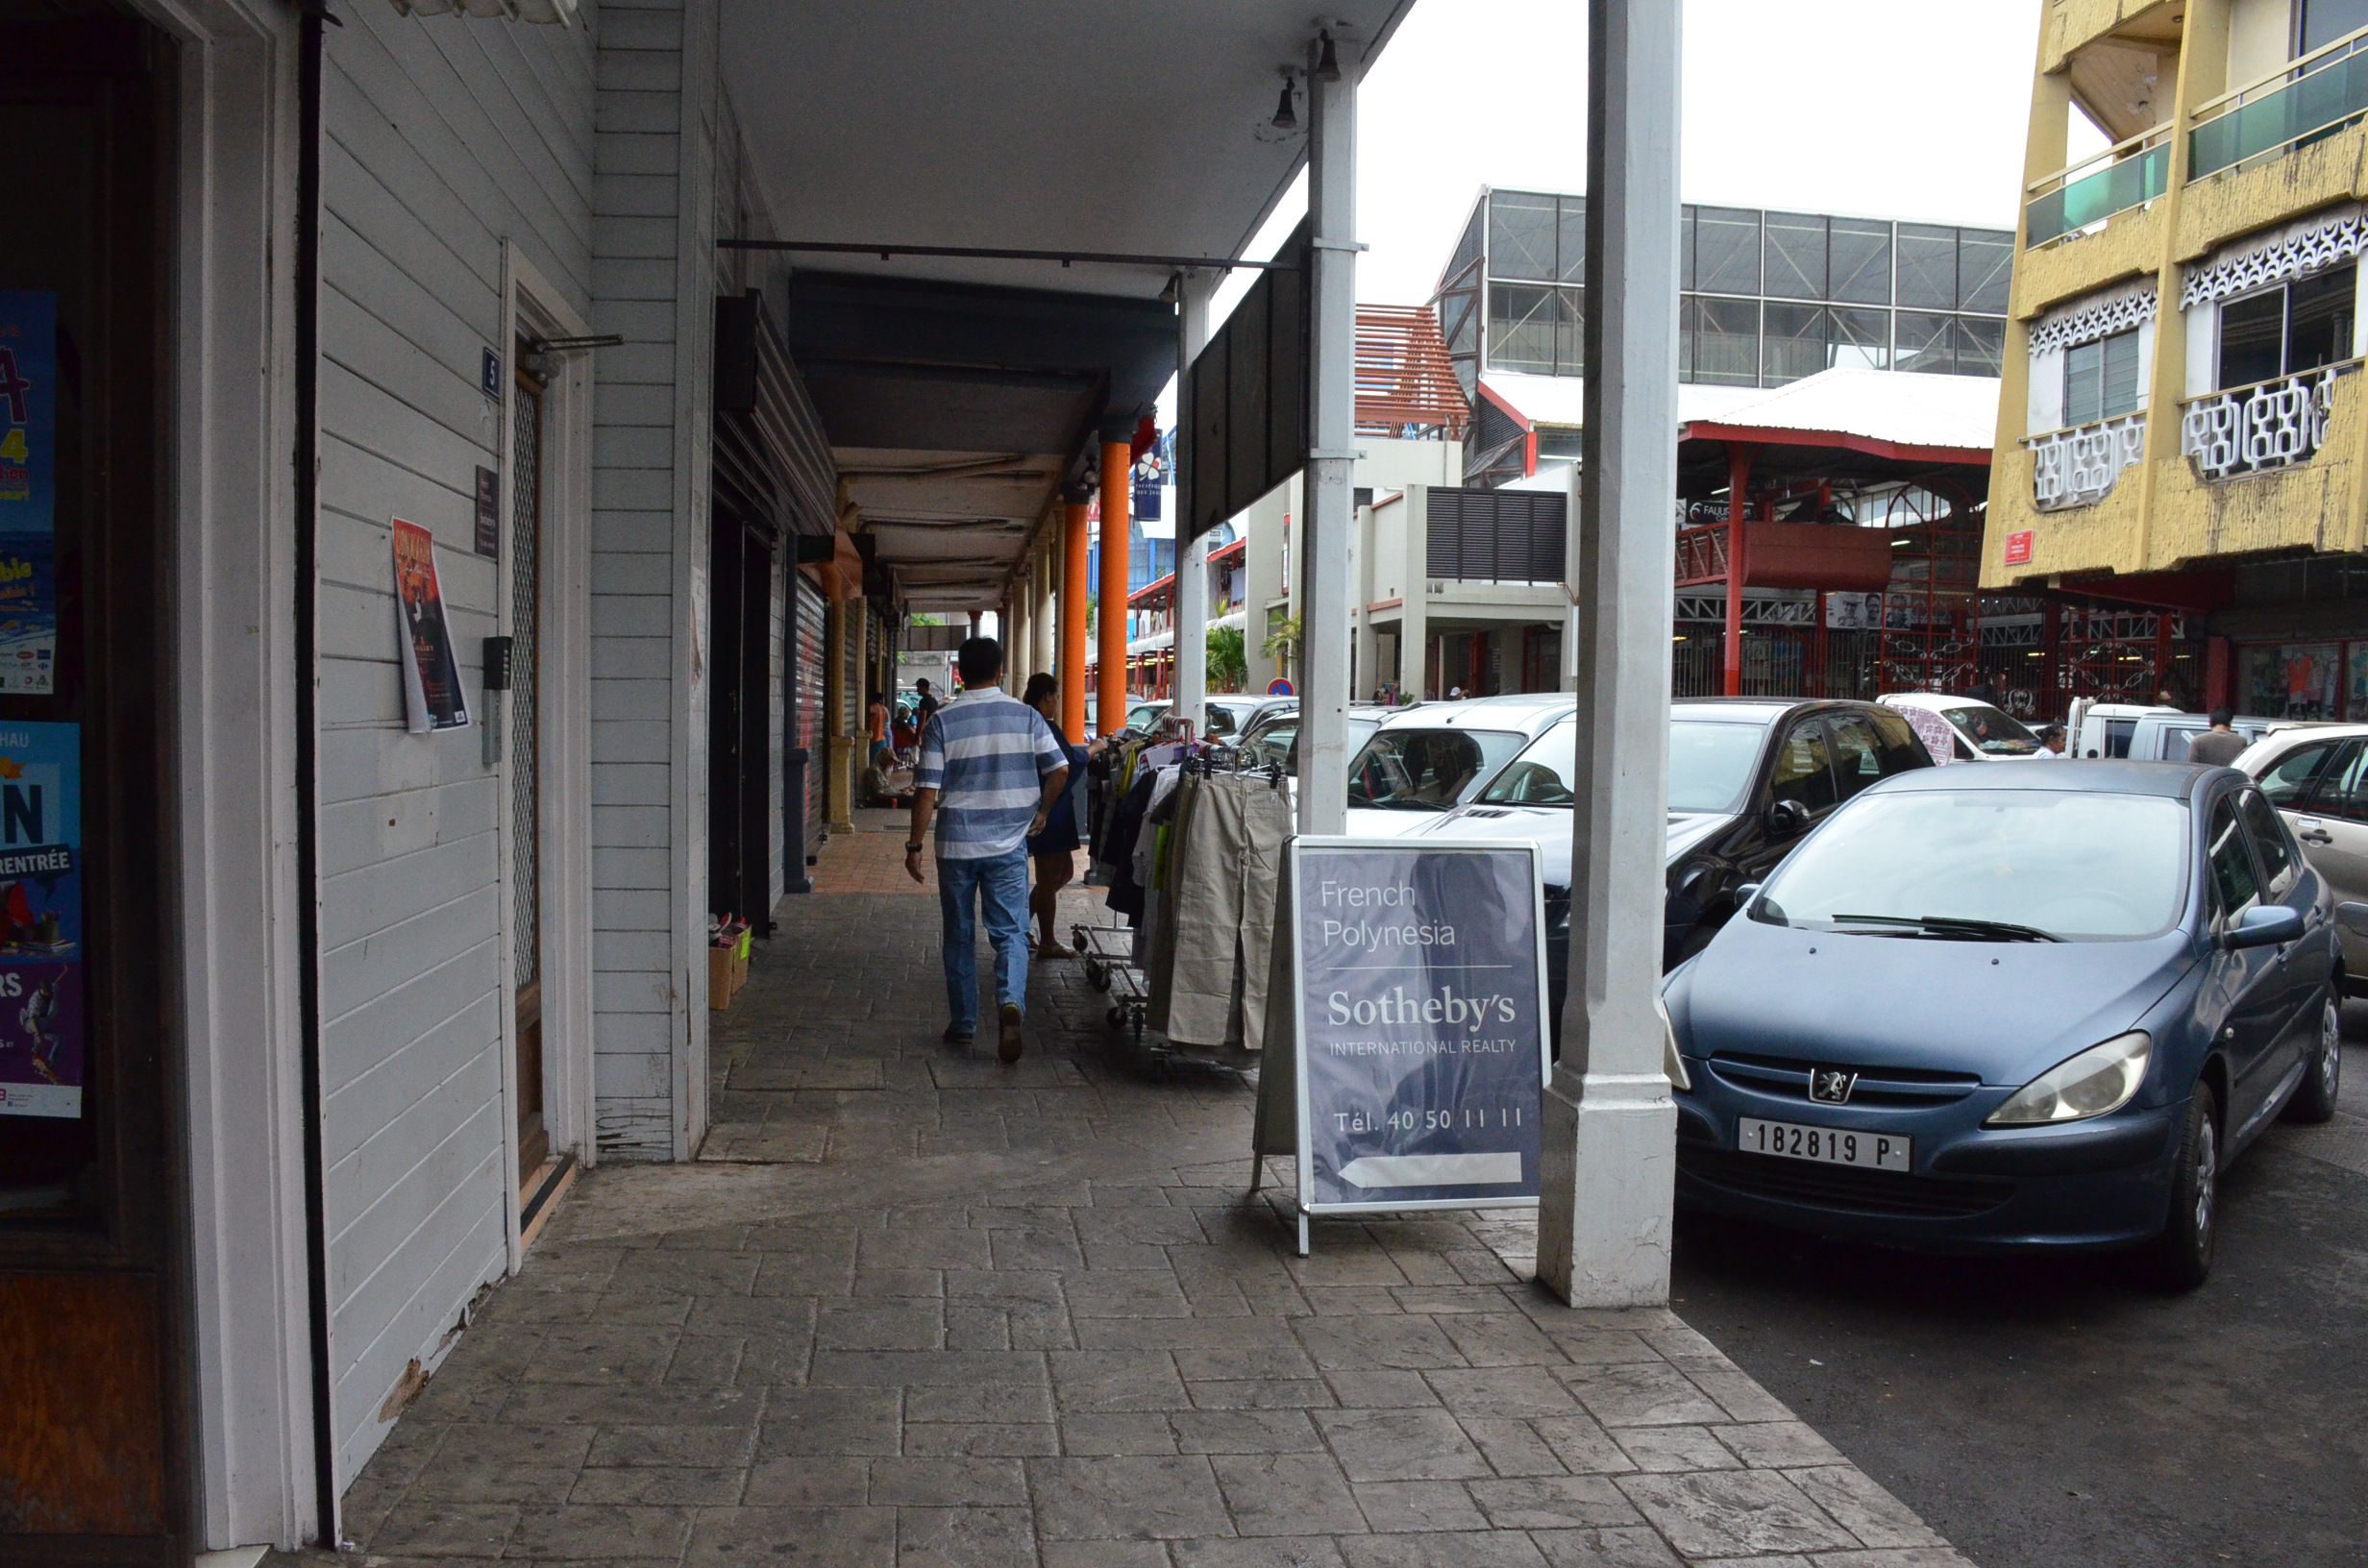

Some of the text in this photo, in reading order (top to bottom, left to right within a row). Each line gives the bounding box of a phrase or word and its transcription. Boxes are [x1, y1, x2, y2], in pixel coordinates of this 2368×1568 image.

[489, 360, 496, 386] 5
[1321, 880, 1416, 907] French
[1323, 919, 1456, 952] Polynesia
[1328, 986, 1516, 1033] Sotheby's
[1329, 1039, 1517, 1057] INTERNATIONAL REALTY
[1334, 1111, 1379, 1133] Tél.
[1388, 1110, 1415, 1131] 40
[1425, 1109, 1451, 1130] 50
[1759, 1123, 1890, 1165] 182819 P
